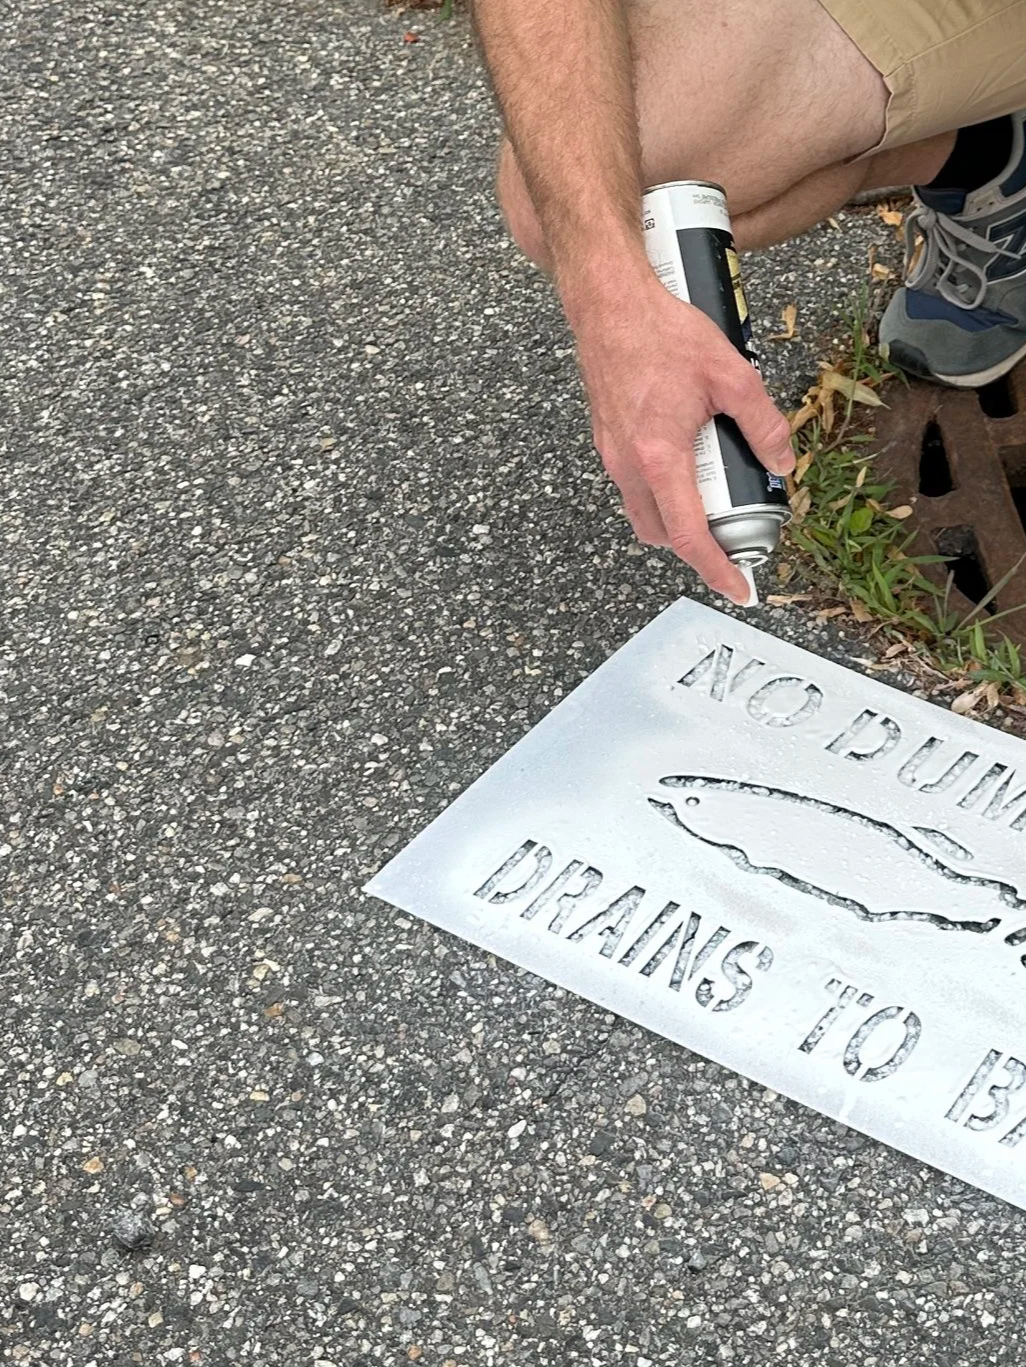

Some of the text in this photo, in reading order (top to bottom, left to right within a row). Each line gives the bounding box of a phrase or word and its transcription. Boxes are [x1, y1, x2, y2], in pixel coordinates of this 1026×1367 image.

[677, 643, 824, 728] NO
[472, 838, 774, 1012] DRAINS
[797, 977, 923, 1083] TO
